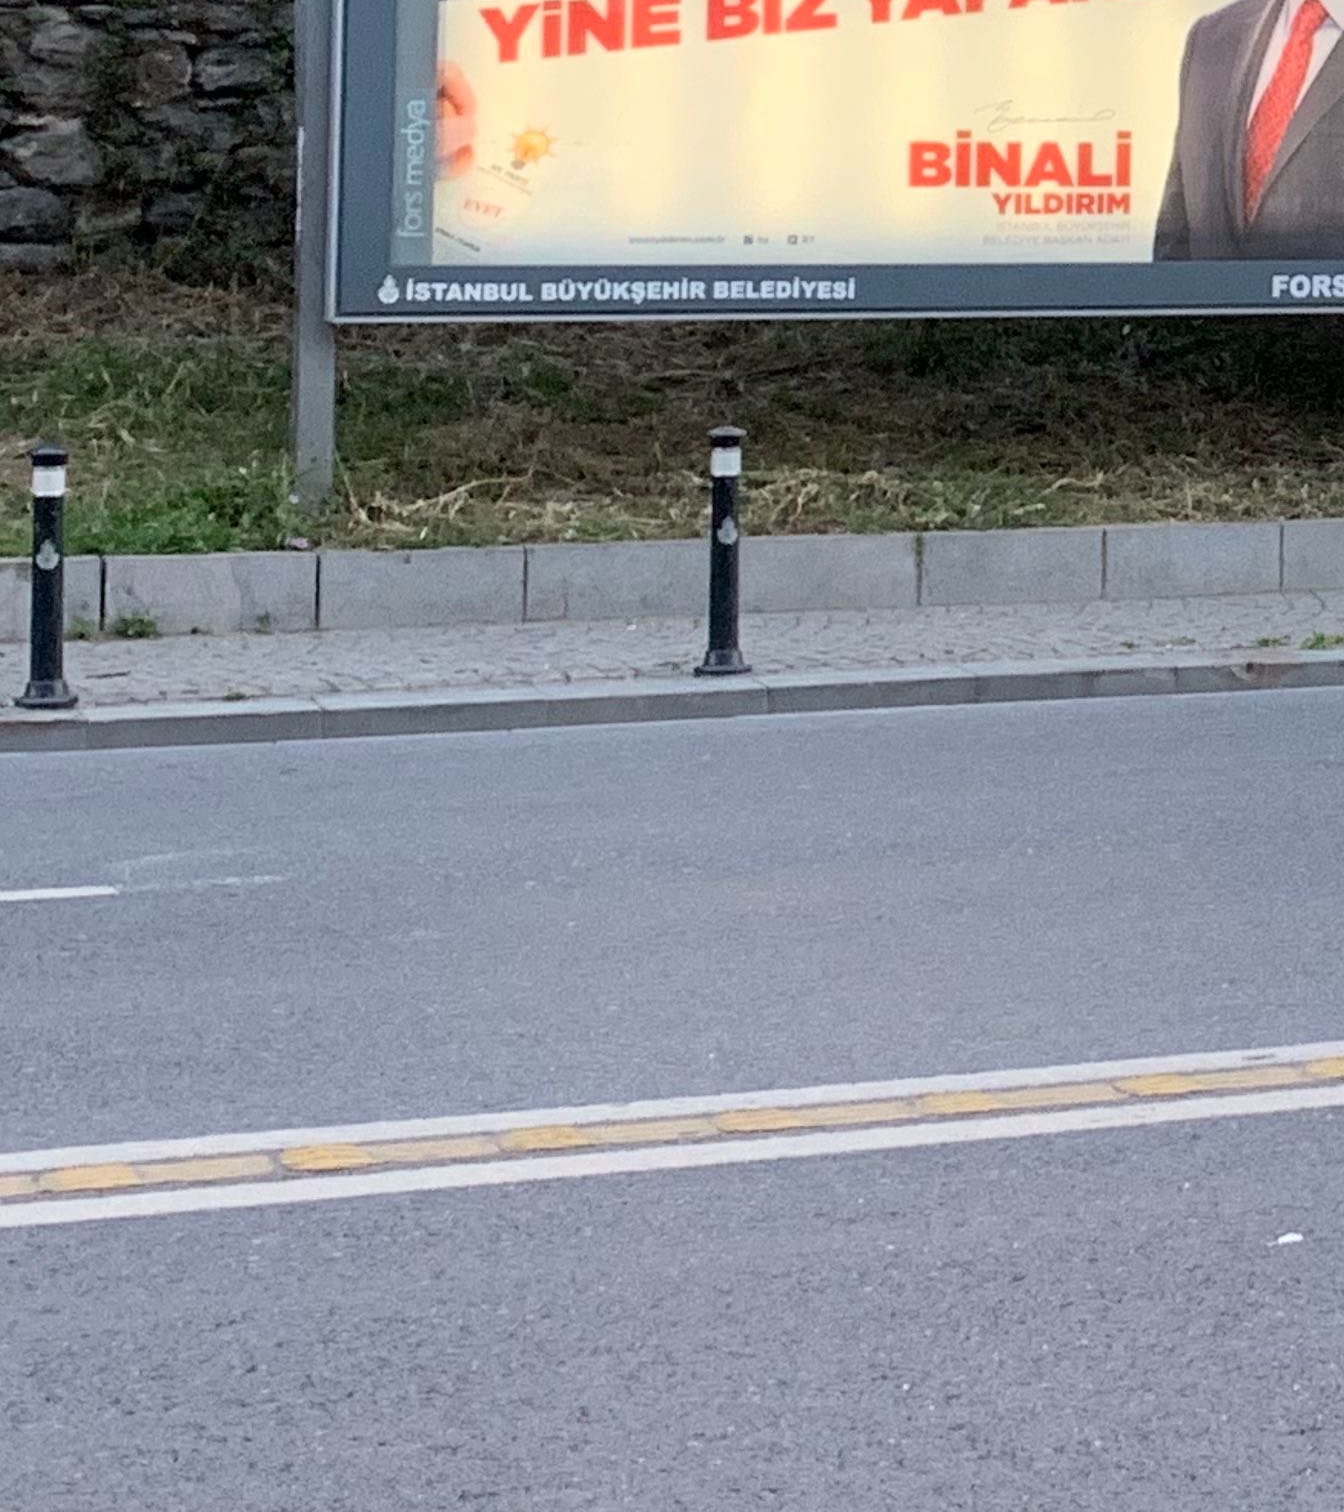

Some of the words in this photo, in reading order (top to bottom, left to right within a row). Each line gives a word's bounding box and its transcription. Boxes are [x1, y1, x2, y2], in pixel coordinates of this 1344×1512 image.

[401, 99, 430, 185] medya
[909, 129, 1133, 188] BİNALİ
[992, 192, 1132, 215] YILDIRIM
[406, 278, 534, 301] İSTANBUL
[541, 276, 706, 304] BÜYÜKŞEHİR
[713, 276, 856, 300] BELEDİYESİ
